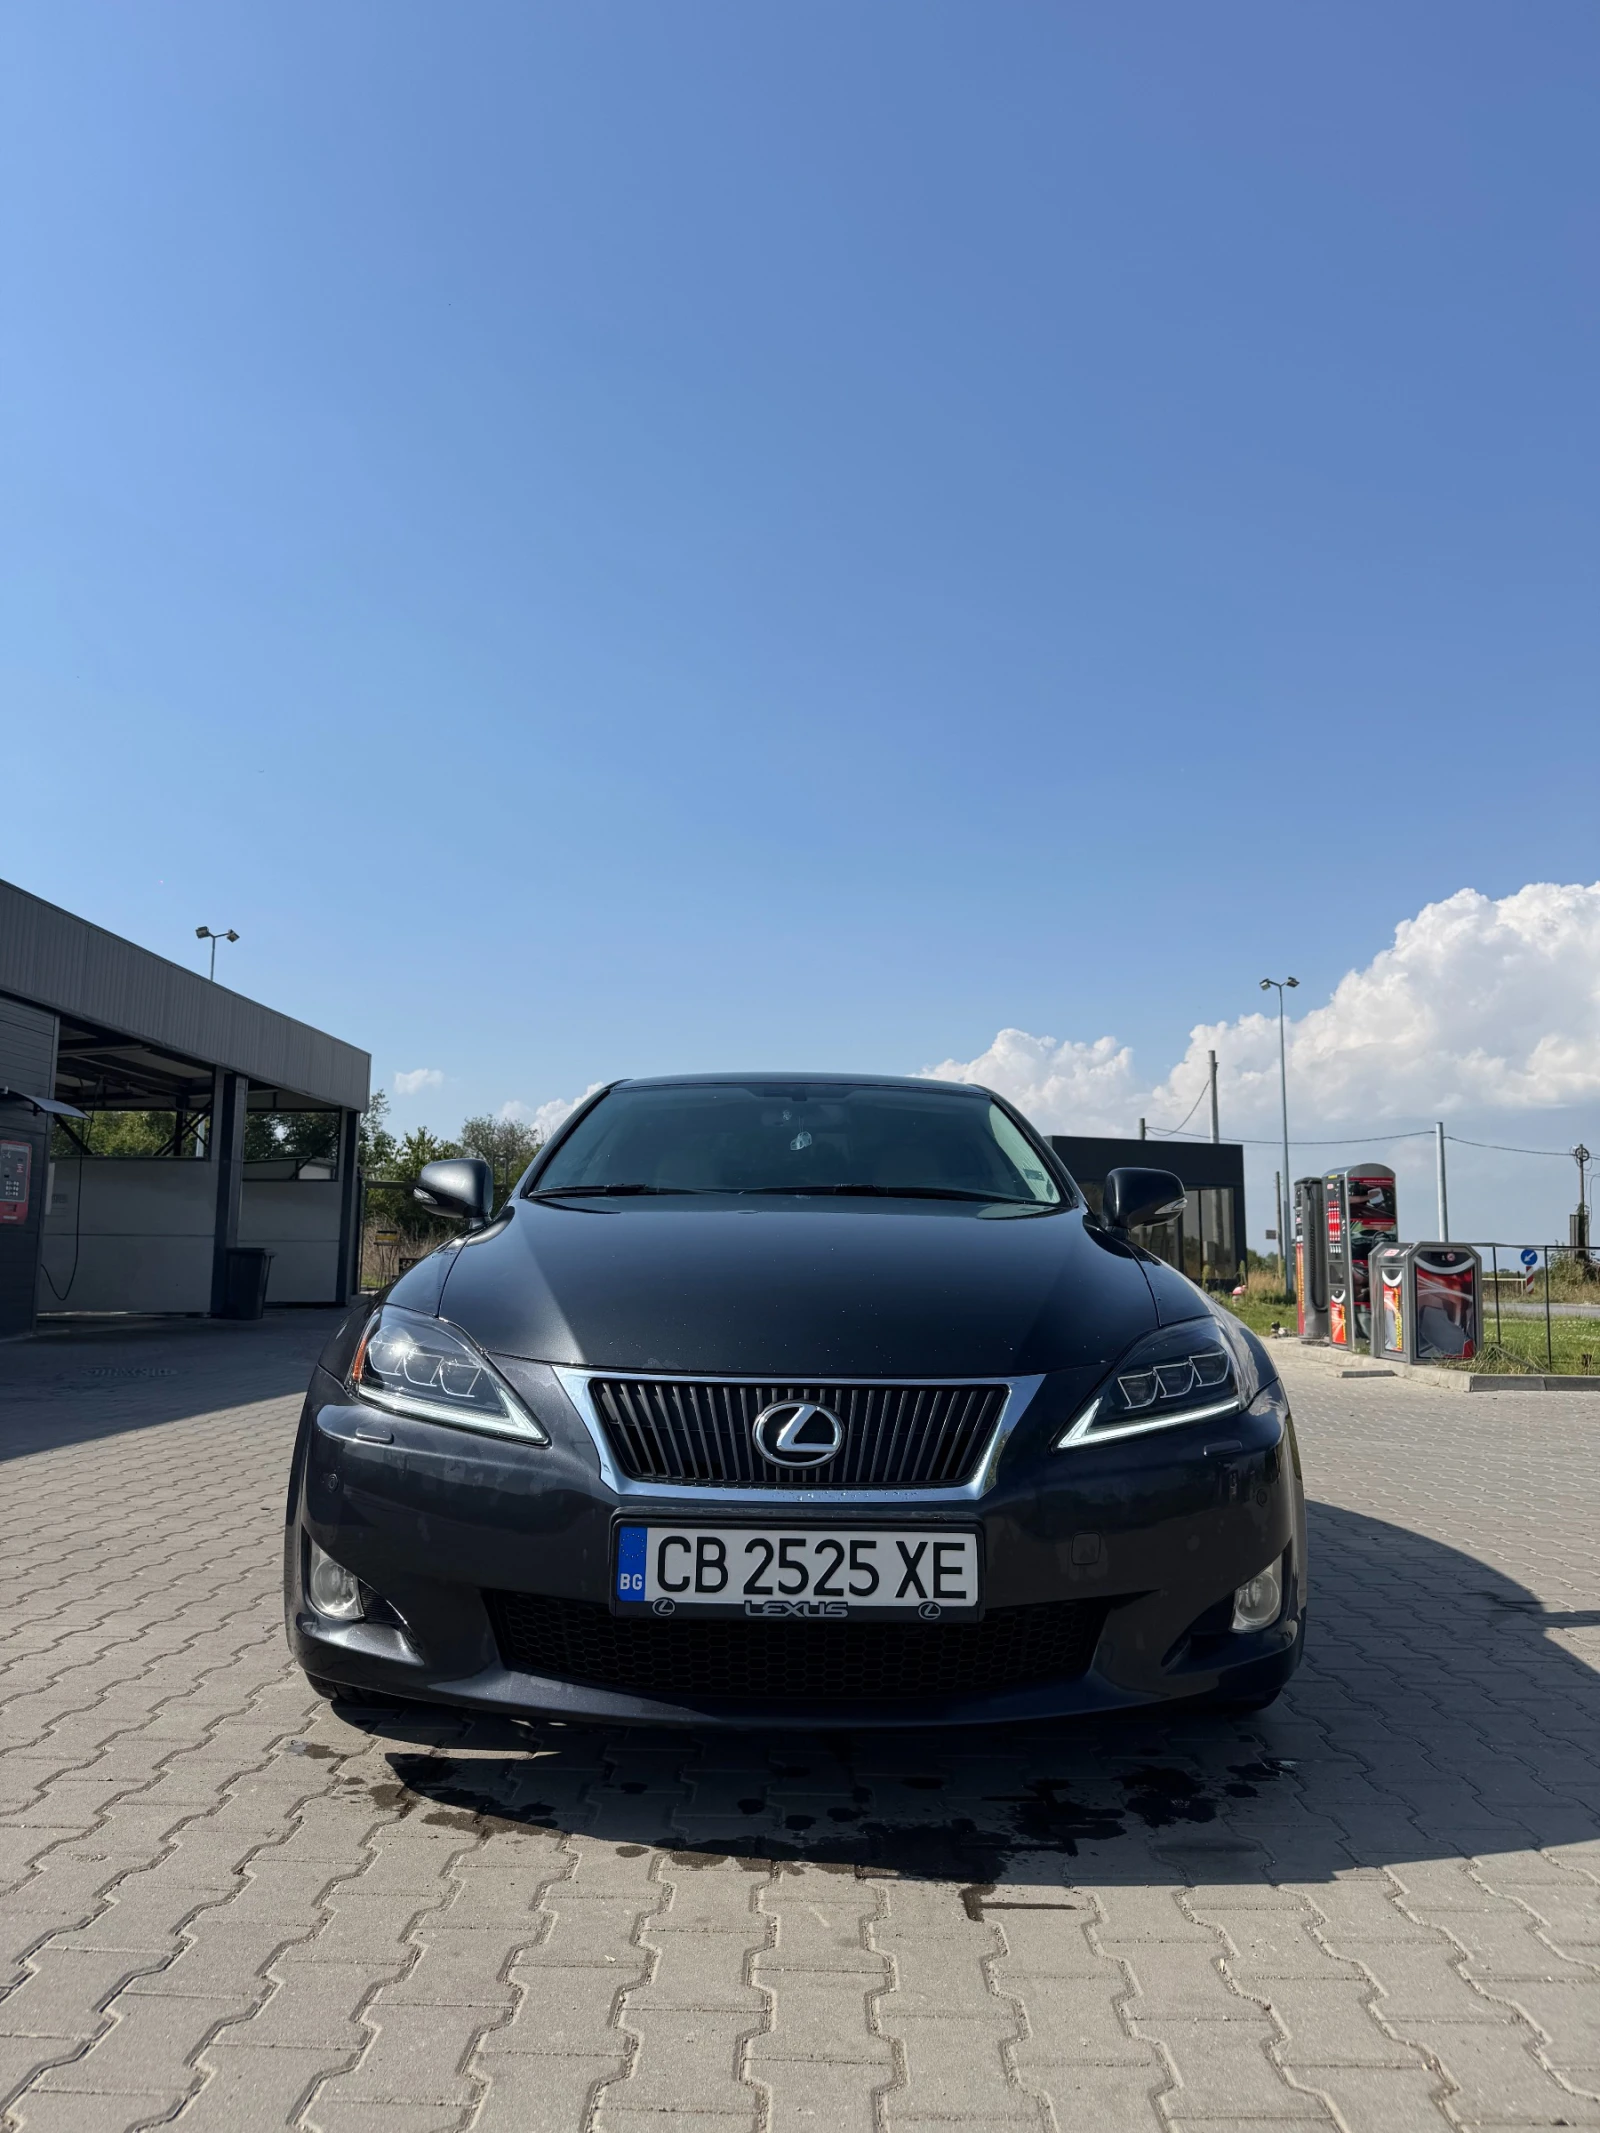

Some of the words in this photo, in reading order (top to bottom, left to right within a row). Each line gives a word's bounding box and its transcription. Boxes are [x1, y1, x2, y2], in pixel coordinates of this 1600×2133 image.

[656, 1536, 729, 1594] CB
[743, 1538, 880, 1597] 2525
[895, 1540, 967, 1600] XE
[619, 1573, 643, 1590] BG
[744, 1600, 849, 1618] LEXUS
